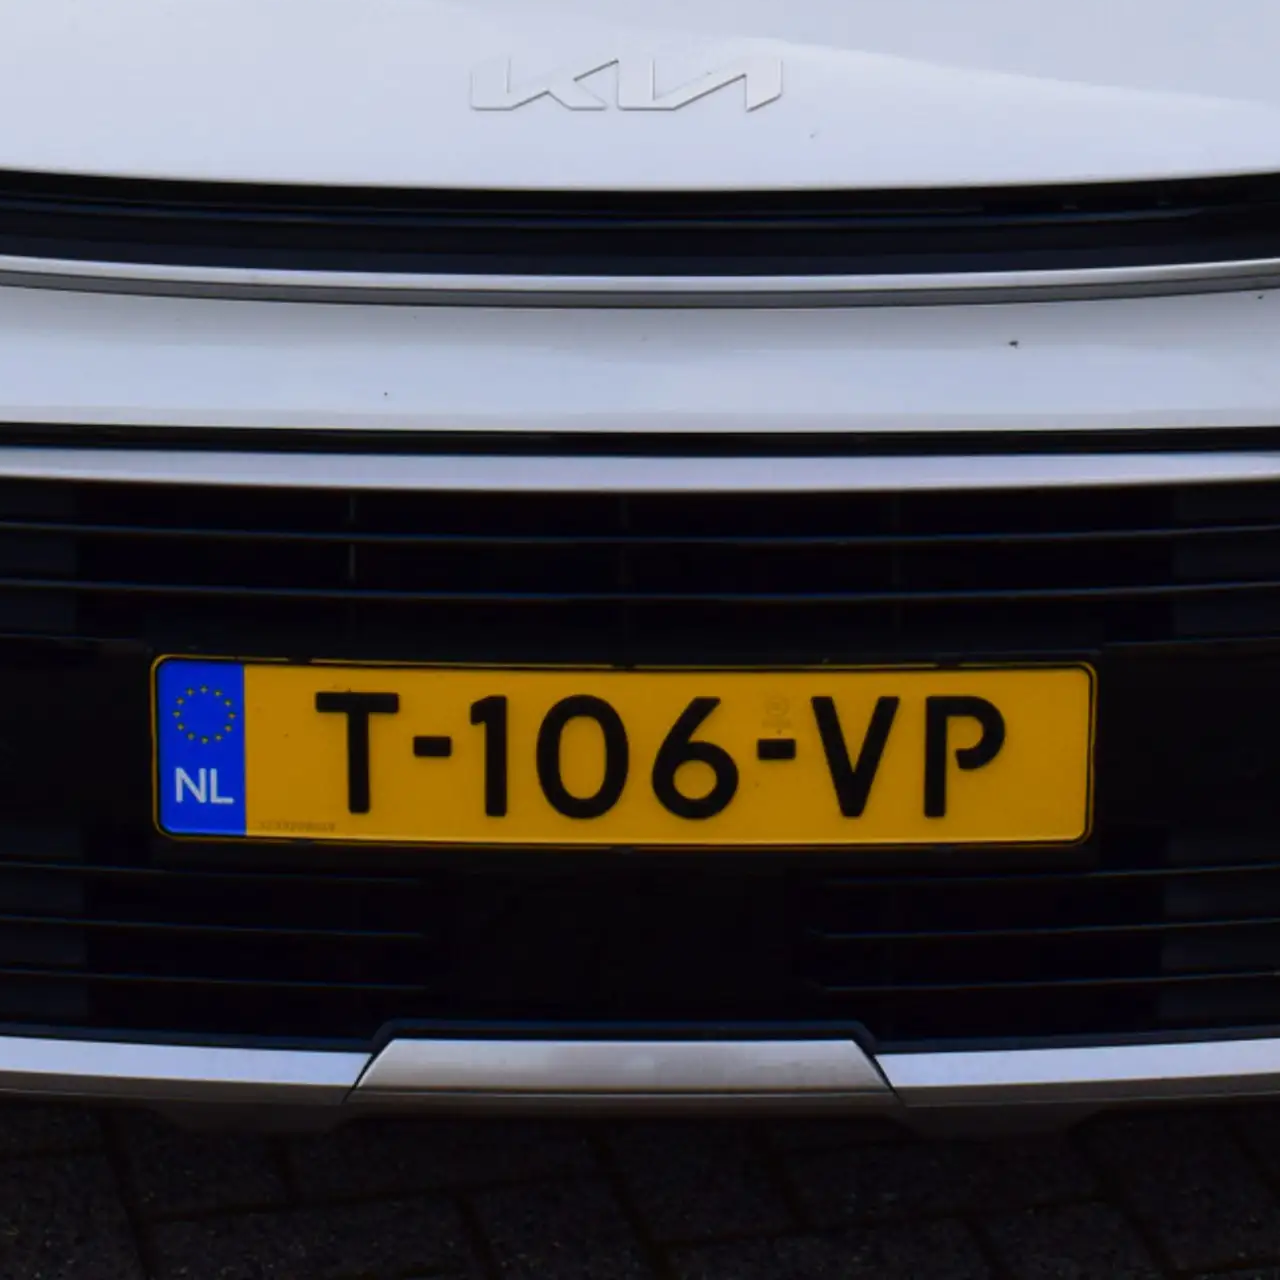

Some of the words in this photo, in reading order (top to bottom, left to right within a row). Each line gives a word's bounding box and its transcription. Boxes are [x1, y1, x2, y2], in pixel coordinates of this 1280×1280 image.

[470, 56, 784, 112] KIA
[314, 692, 1006, 821] T-106-VP
[174, 768, 234, 806] NL
